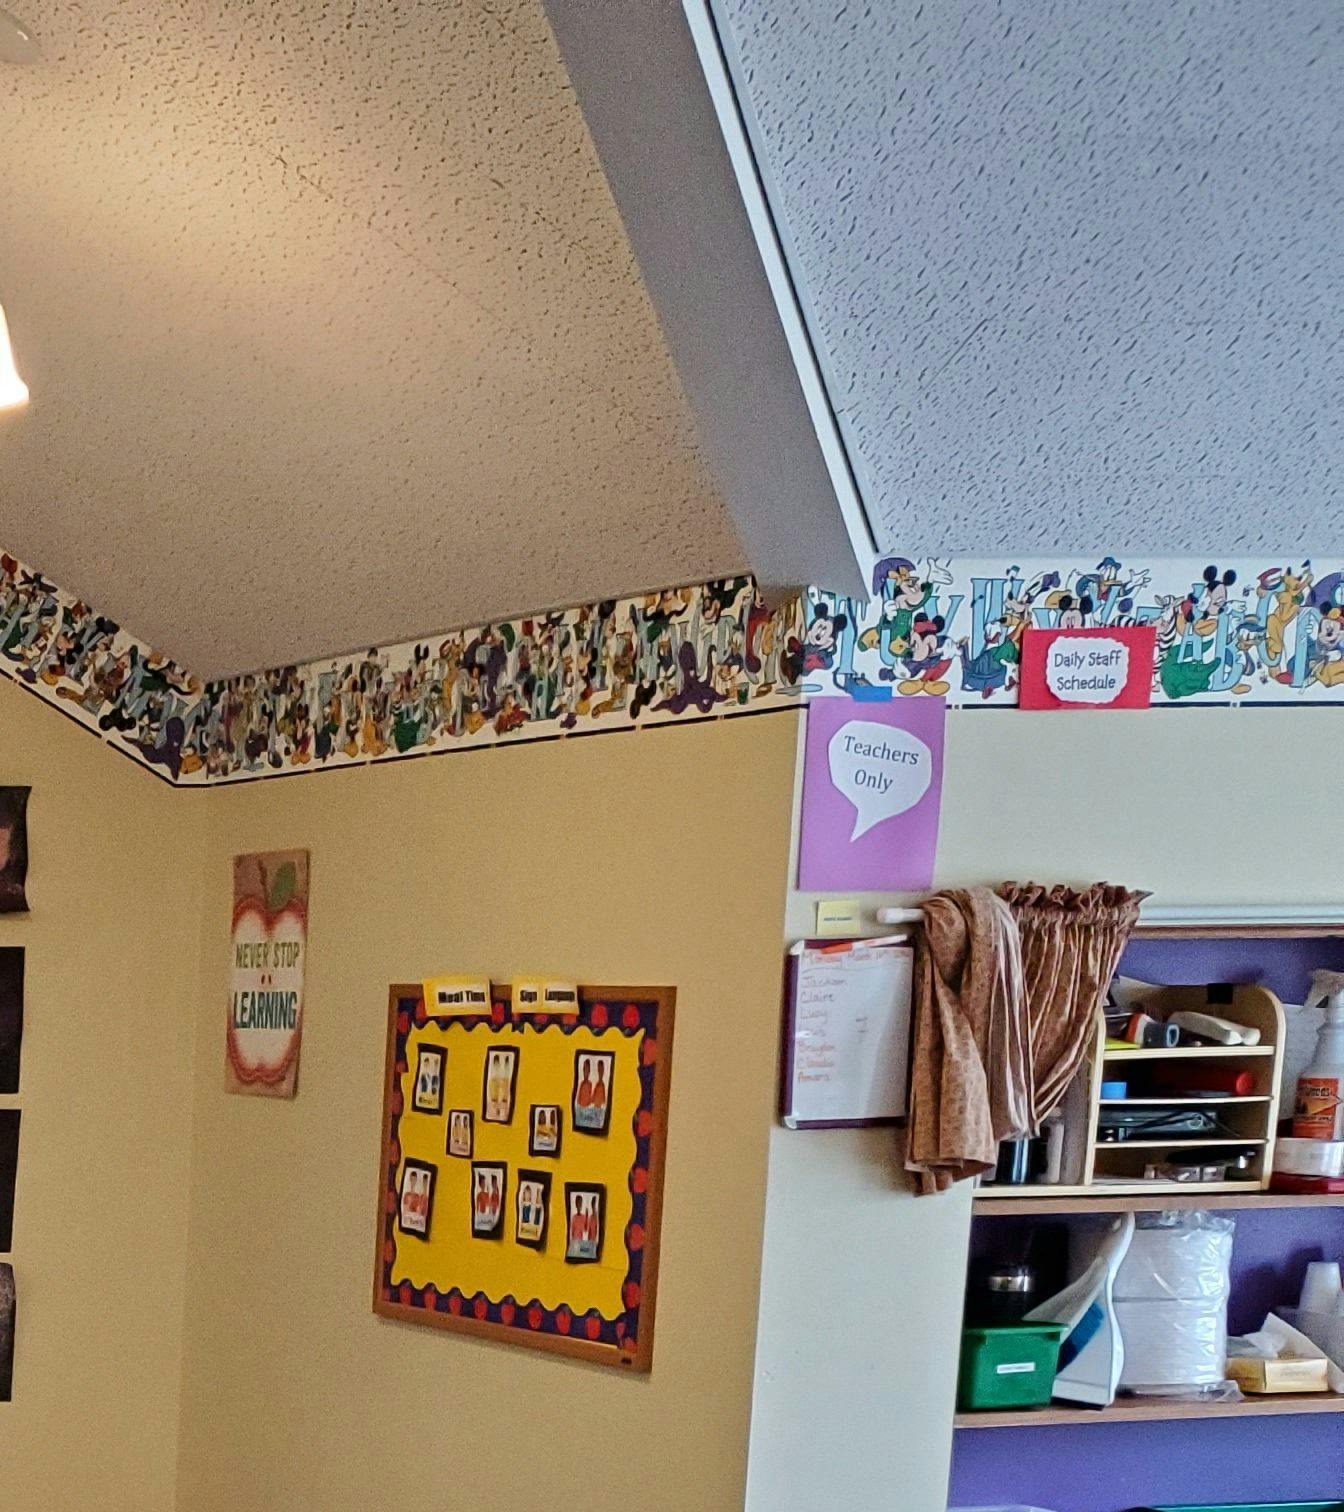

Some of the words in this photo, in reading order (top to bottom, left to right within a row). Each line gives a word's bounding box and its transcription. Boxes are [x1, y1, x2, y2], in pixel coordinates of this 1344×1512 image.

[1054, 651, 1085, 668] Daily
[1088, 650, 1121, 666] Staff
[1056, 674, 1116, 691] Schedule
[844, 735, 919, 767] Teachers
[854, 768, 893, 794] Only
[235, 942, 269, 969] NEVER
[273, 941, 300, 969] STOP
[233, 991, 298, 1030] LEARNING
